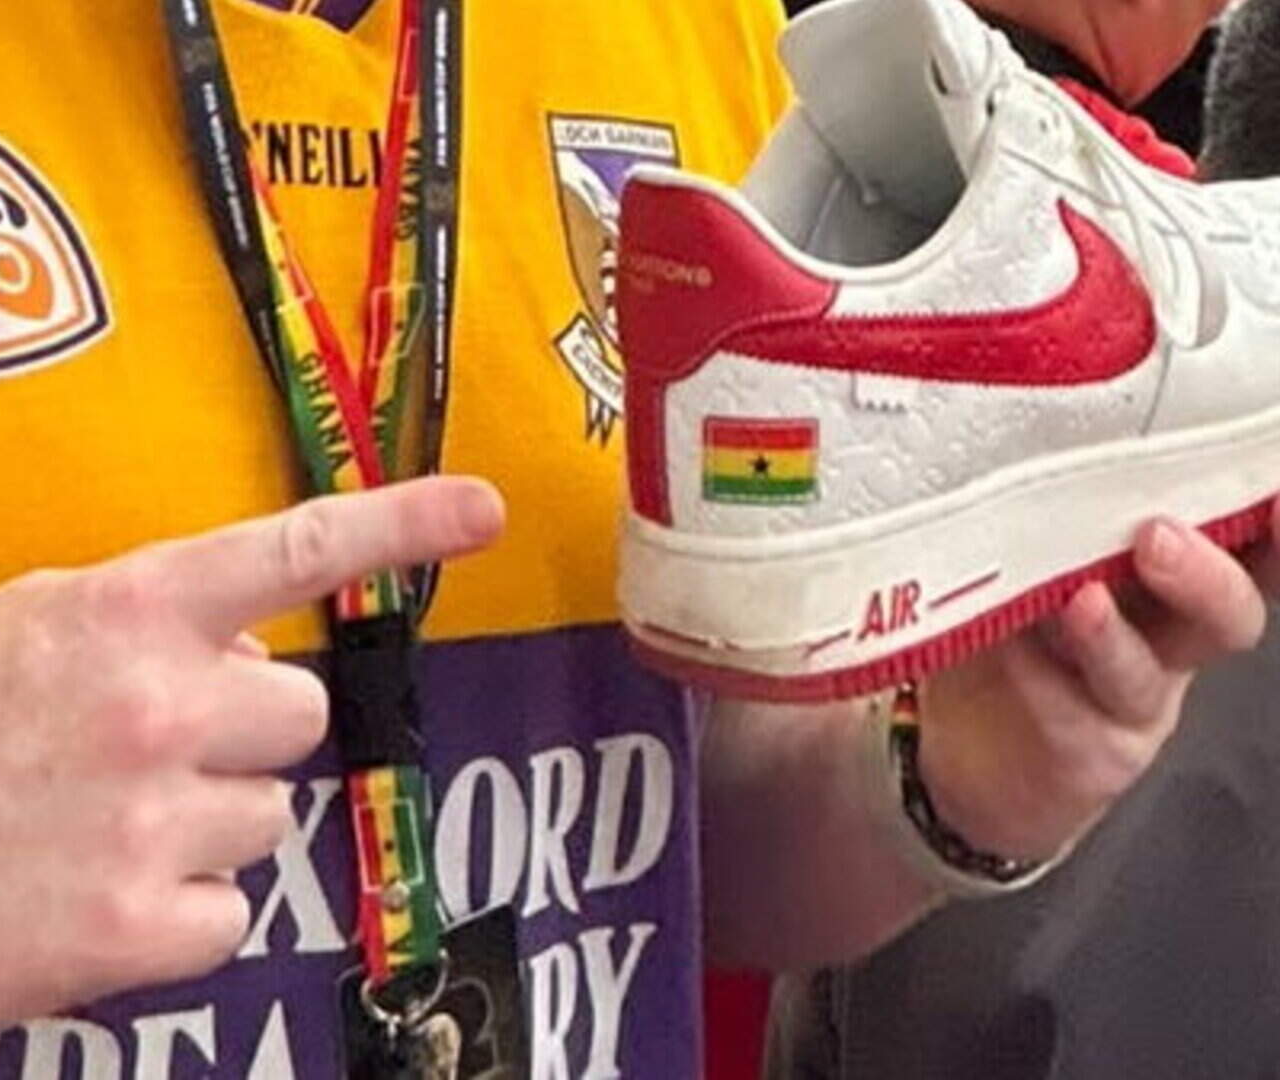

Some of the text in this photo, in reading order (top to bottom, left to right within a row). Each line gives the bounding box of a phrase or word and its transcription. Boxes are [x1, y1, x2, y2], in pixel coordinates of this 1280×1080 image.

[297, 351, 356, 472] GHANA
[857, 579, 921, 641] AIR
[237, 733, 674, 959] XORD
